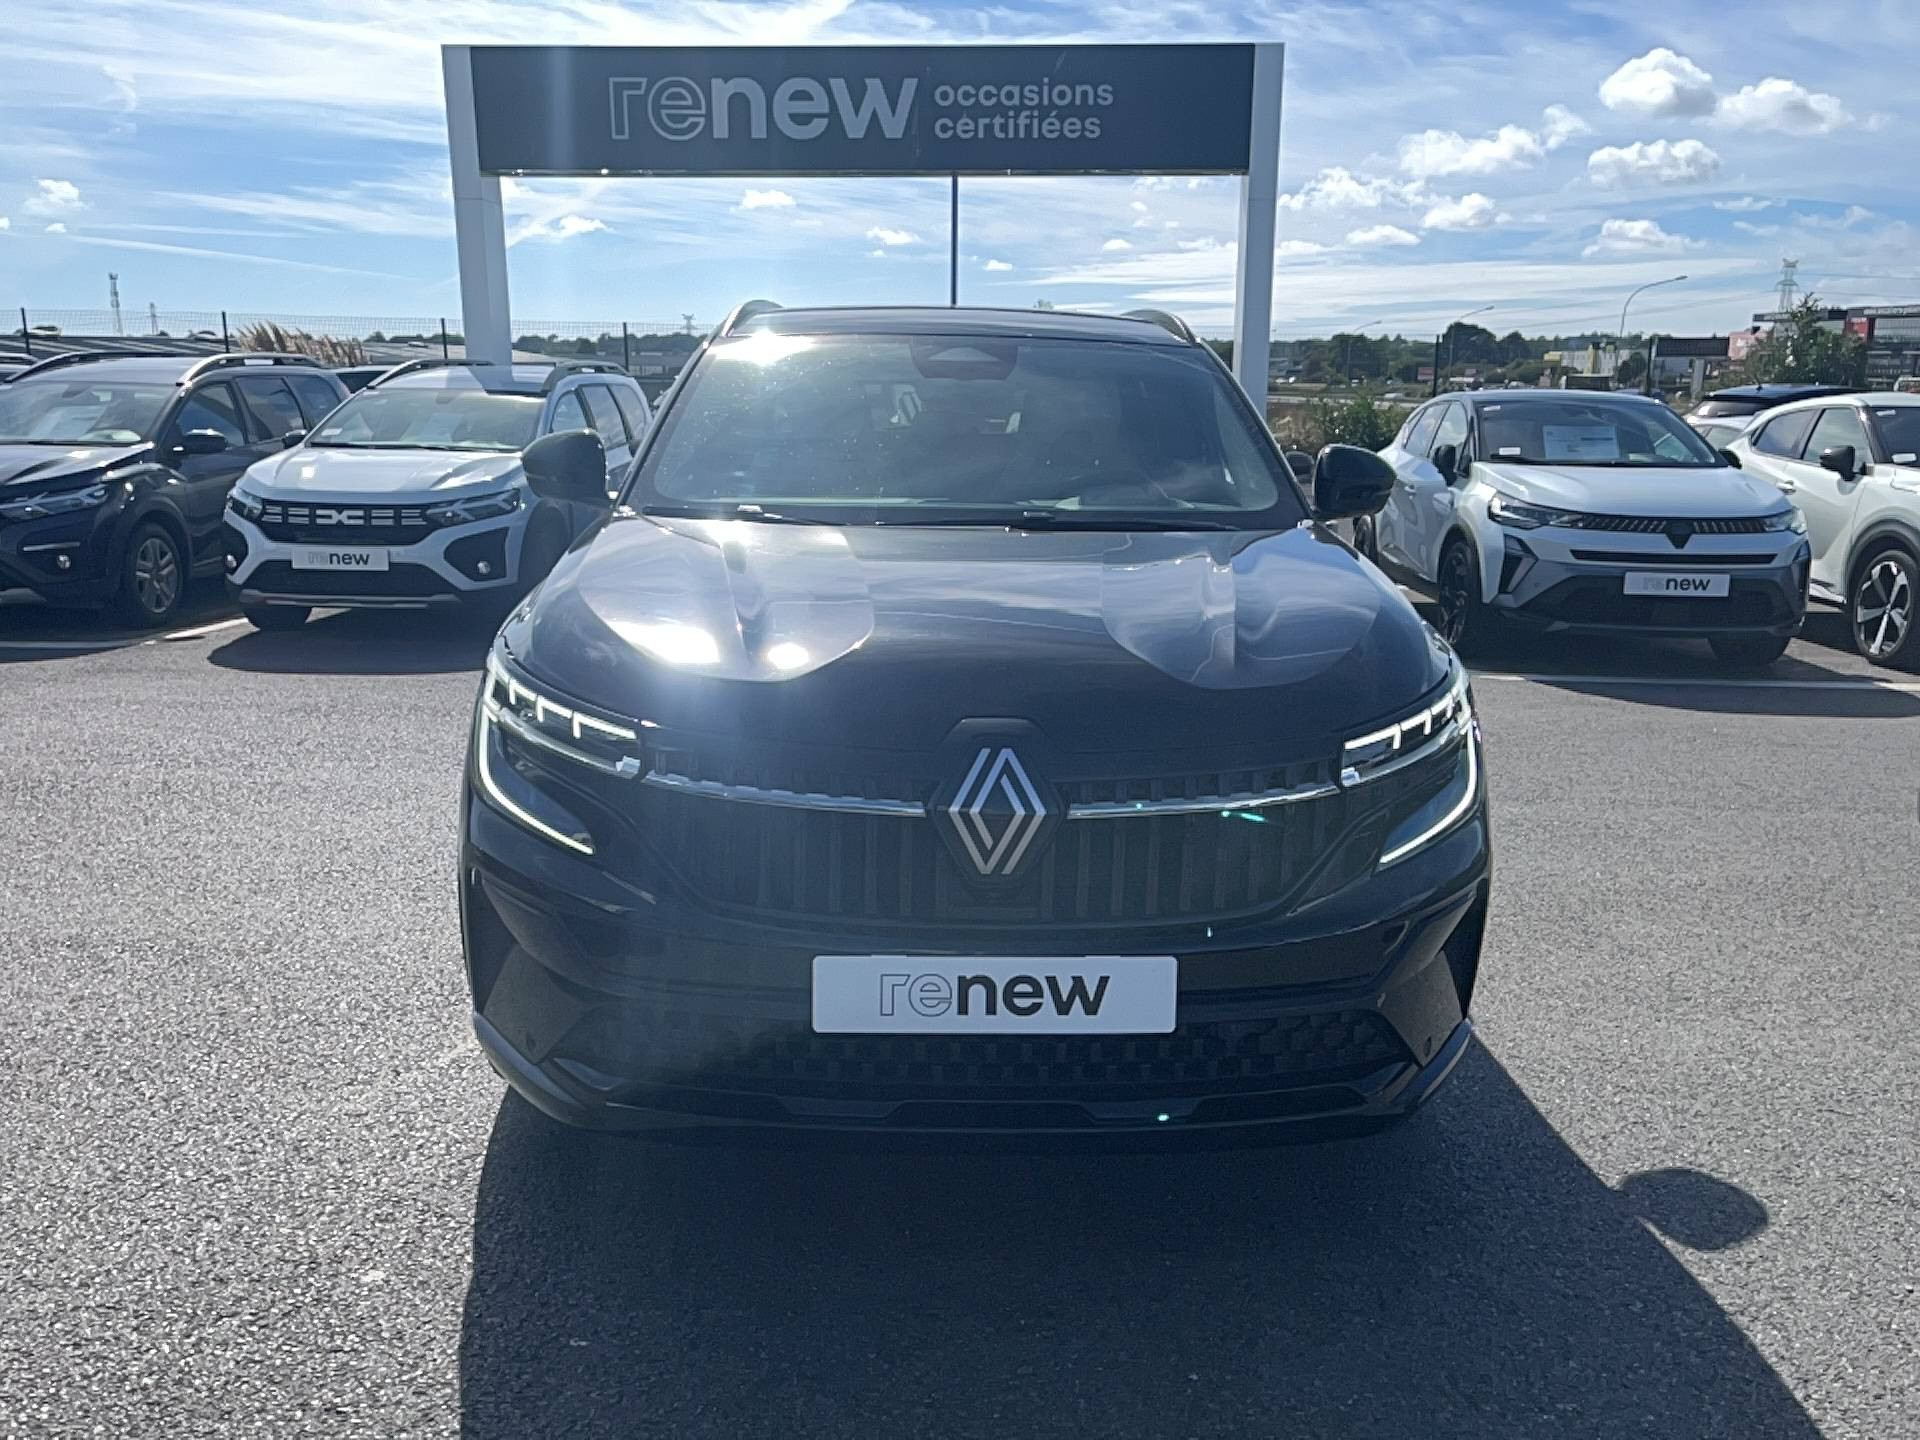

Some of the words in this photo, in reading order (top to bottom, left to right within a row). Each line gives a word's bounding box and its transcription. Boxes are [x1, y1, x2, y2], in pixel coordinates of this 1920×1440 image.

[934, 77, 1114, 106] occasions
[608, 77, 919, 141] renew
[307, 551, 371, 566] new
[1642, 577, 1711, 592] new
[879, 973, 1111, 1017] renew
